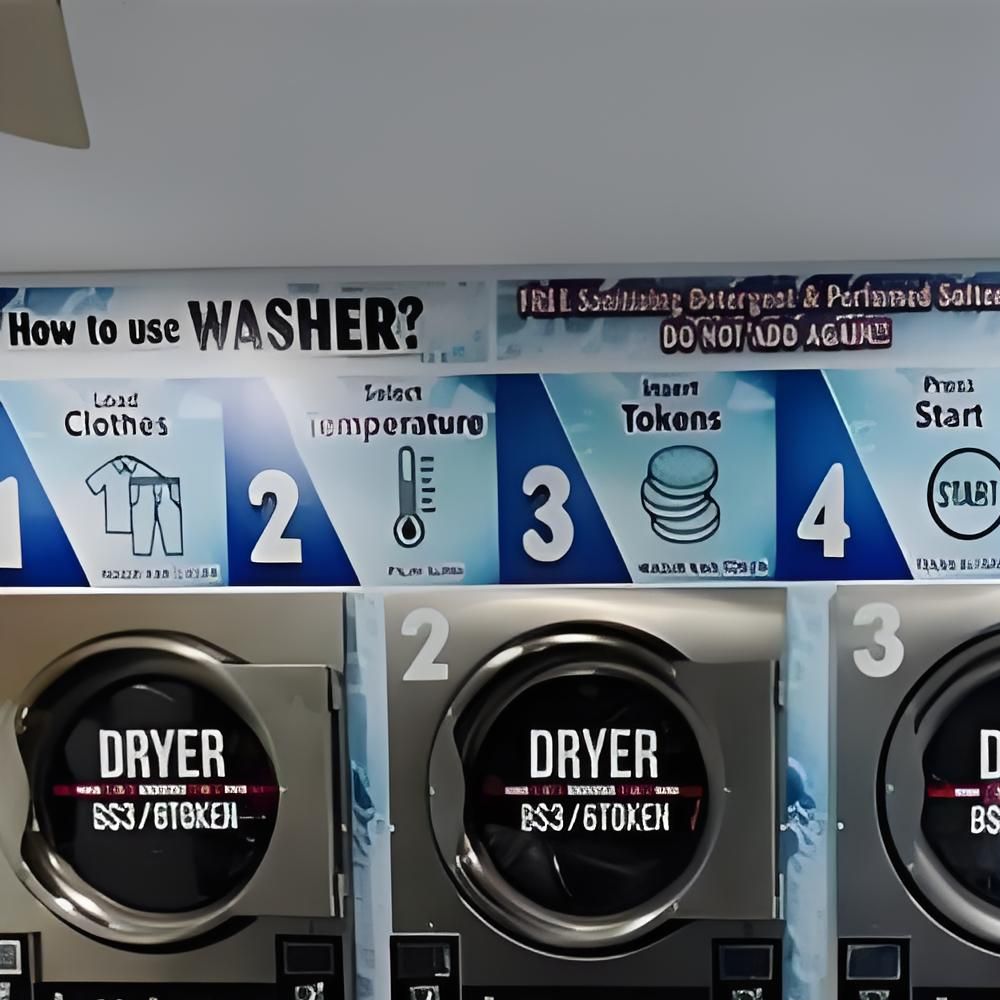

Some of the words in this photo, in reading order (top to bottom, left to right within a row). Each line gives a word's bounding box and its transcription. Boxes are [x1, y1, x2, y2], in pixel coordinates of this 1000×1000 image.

[9, 312, 76, 346] How
[87, 315, 117, 345] to
[129, 318, 180, 345] use
[188, 296, 424, 352] WASHER?
[65, 410, 168, 437] Clothes
[916, 400, 983, 429] Start
[248, 469, 303, 564] 2
[522, 465, 574, 562] 3
[797, 462, 851, 558] 4
[401, 608, 450, 682] 2
[852, 602, 905, 678] 3
[99, 729, 226, 779] DRYER
[530, 728, 658, 779] DRYER
